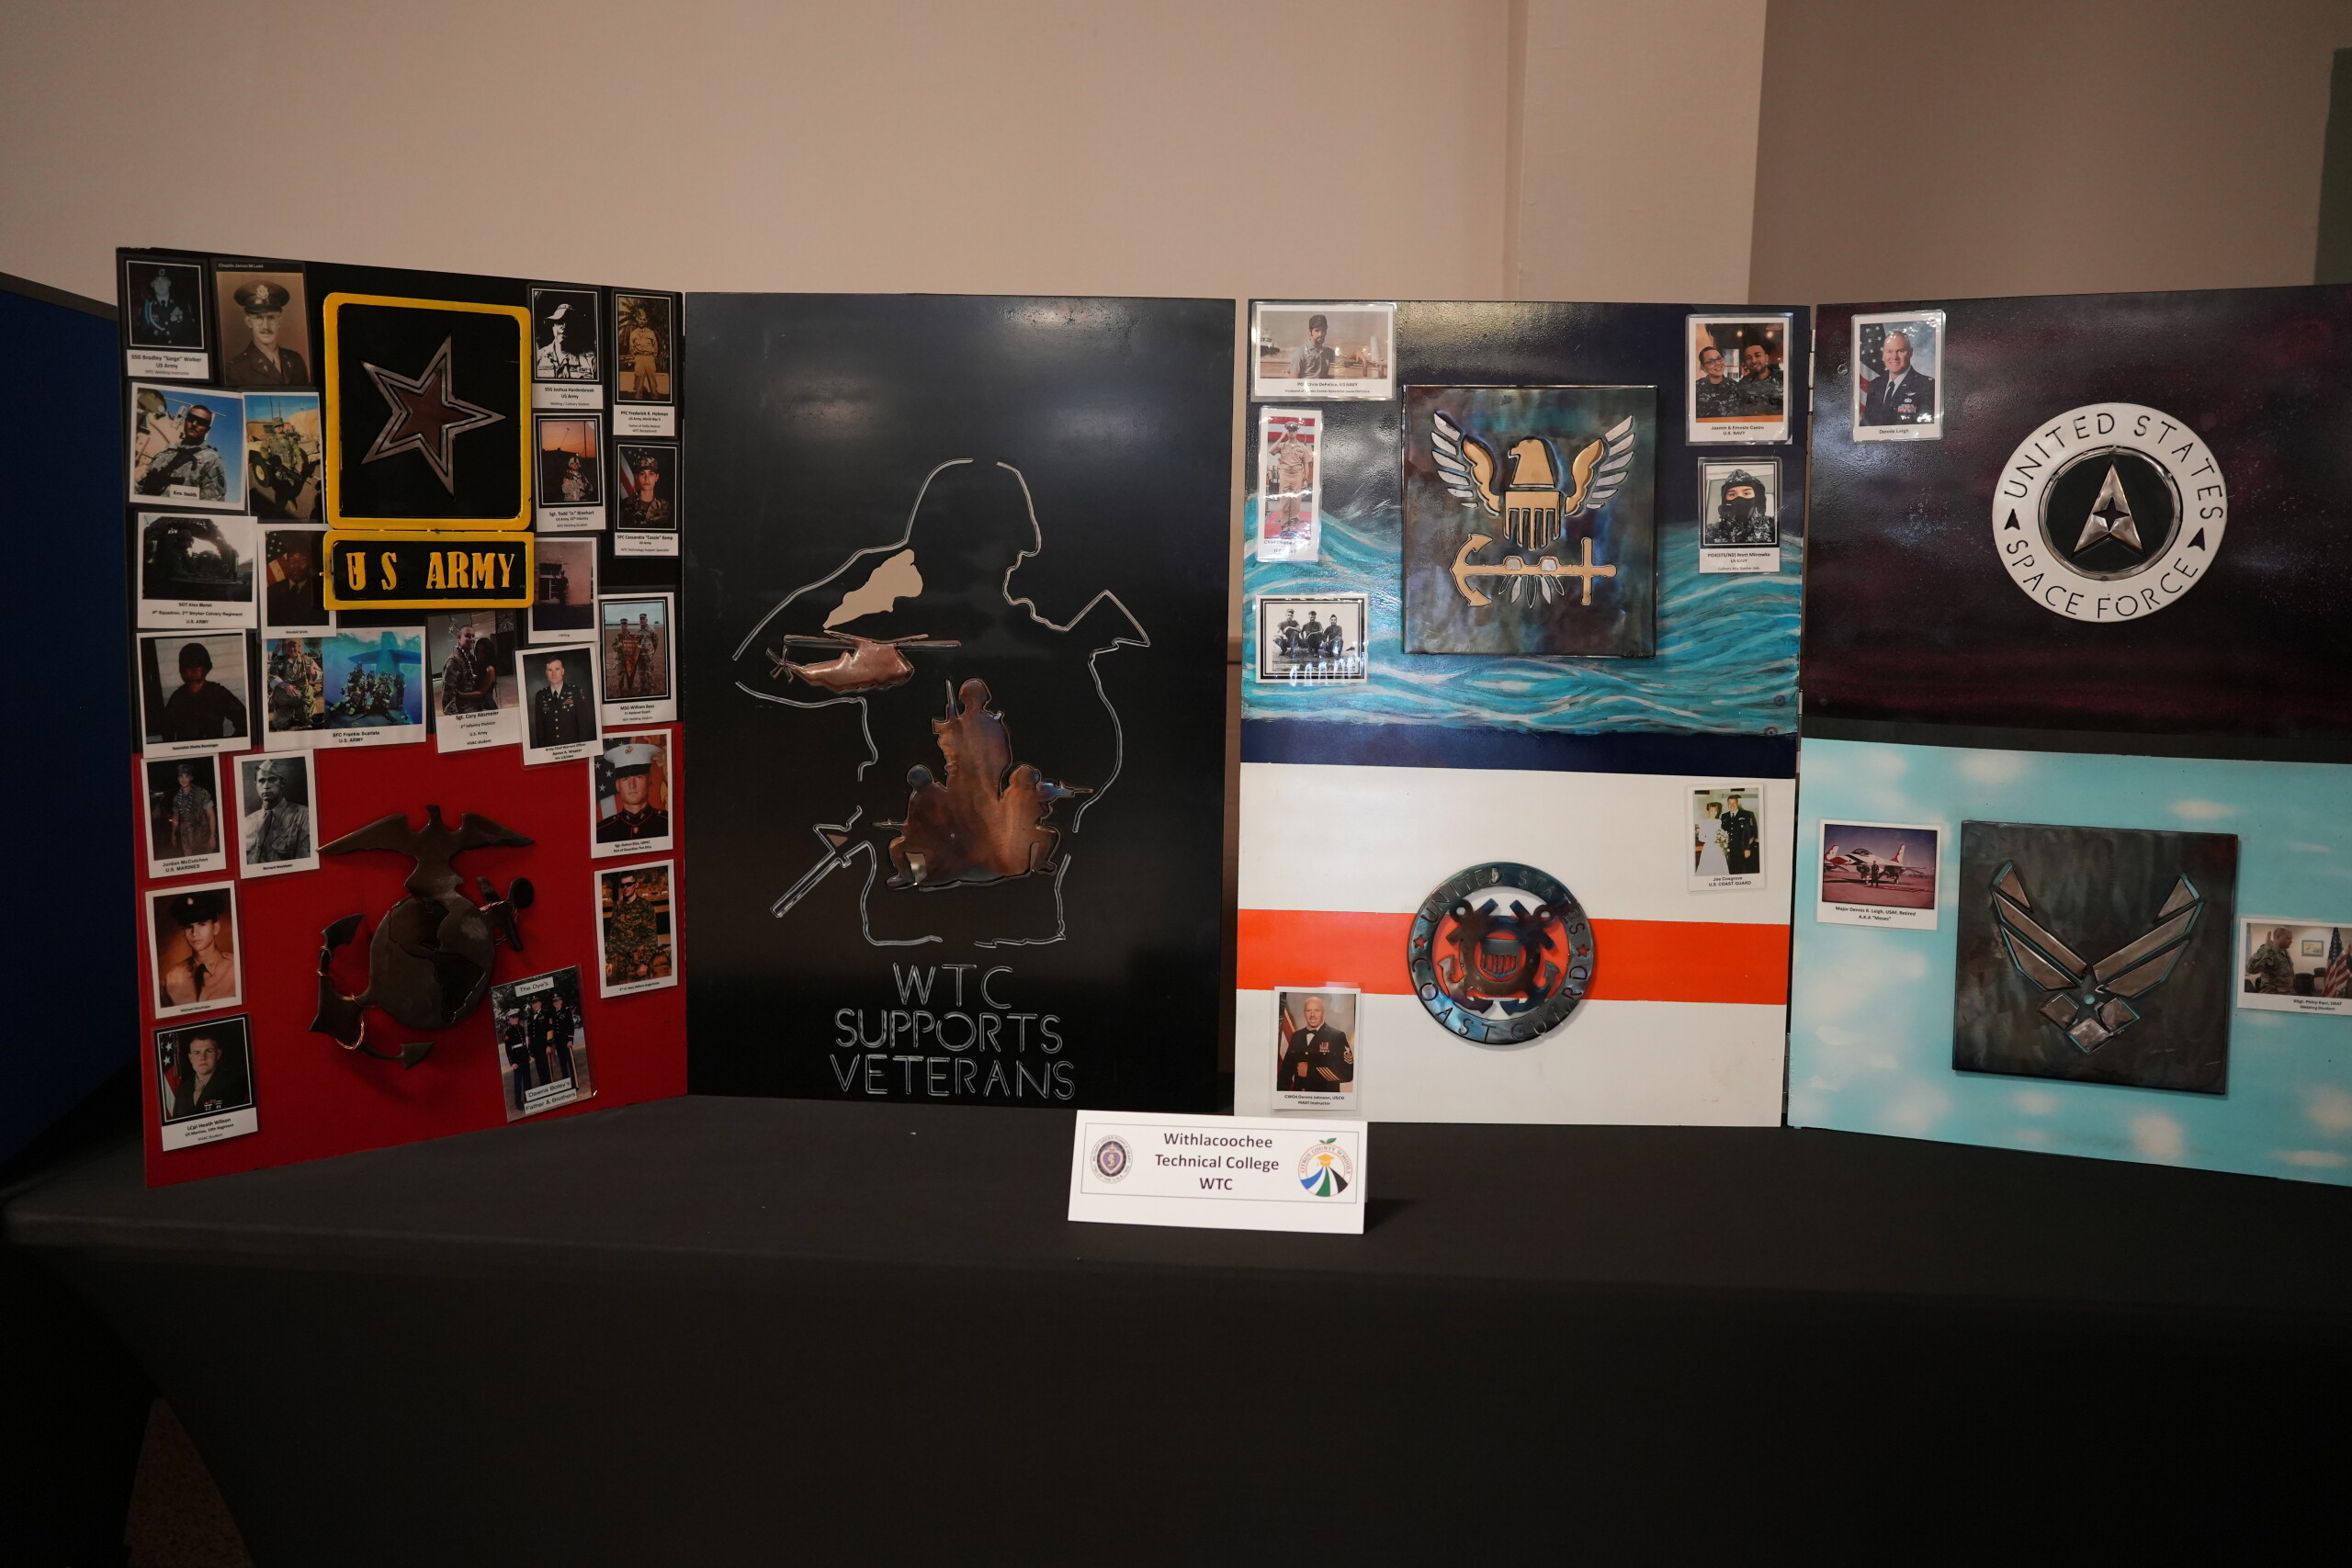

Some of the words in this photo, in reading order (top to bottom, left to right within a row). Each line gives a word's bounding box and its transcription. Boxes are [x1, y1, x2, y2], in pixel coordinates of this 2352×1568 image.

[2004, 412, 2115, 498] UNITED
[2133, 415, 2223, 520] STATES
[345, 551, 367, 591] U
[381, 551, 398, 591] S
[425, 551, 515, 590] ARMY
[2007, 539, 2085, 615] SPACE
[2097, 558, 2199, 619] FORCE
[1420, 867, 1502, 924] UNITED
[1518, 870, 1586, 935] STATES
[892, 963, 1013, 1010] WTC
[1411, 957, 1497, 1043] COAST
[1510, 965, 1589, 1040] GUARD
[834, 1009, 1063, 1055] SUPPORTS
[830, 1054, 1076, 1100] VETERANS
[526, 1101, 545, 1111] Father
[1155, 1154, 1222, 1168] Technical
[1226, 1156, 1280, 1172] College
[1163, 1132, 1273, 1148] Withlacoochee
[1300, 1153, 1312, 1174] CITRUS
[1311, 1145, 1336, 1154] COUNTY
[1337, 1149, 1351, 1175] SCHOOLS
[1199, 1178, 1233, 1190] WTC
